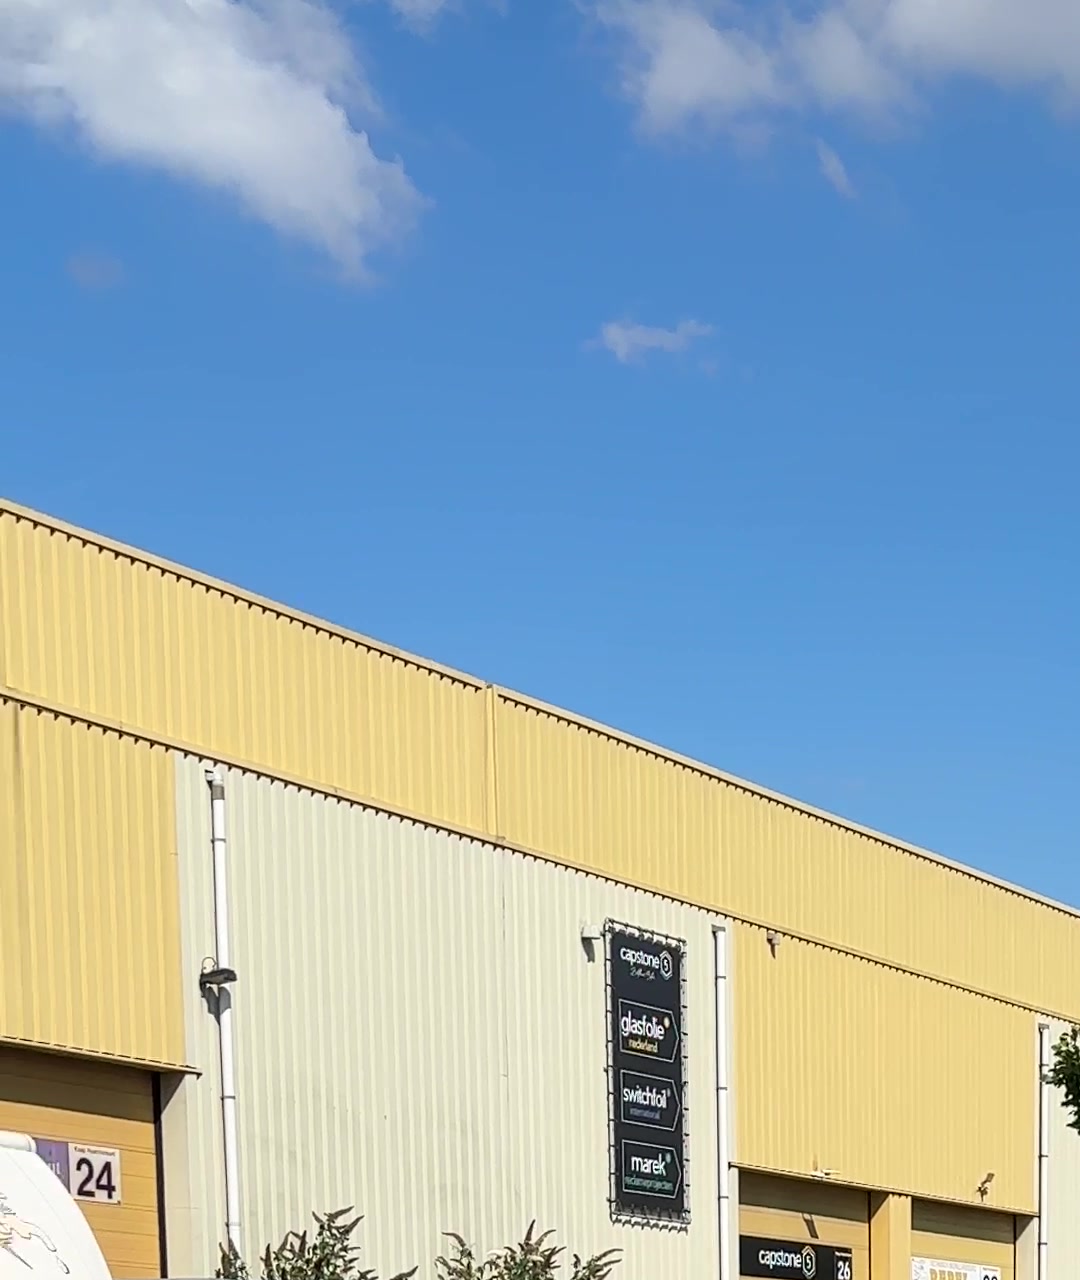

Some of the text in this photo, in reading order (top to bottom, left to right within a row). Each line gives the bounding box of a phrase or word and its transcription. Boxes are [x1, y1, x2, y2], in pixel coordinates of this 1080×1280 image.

[620, 947, 660, 970] capstone
[621, 1010, 665, 1041] glasfolie
[631, 1153, 666, 1176] marek
[76, 1157, 116, 1199] 24
[759, 1249, 802, 1269] capstone
[837, 1261, 851, 1280] 26
